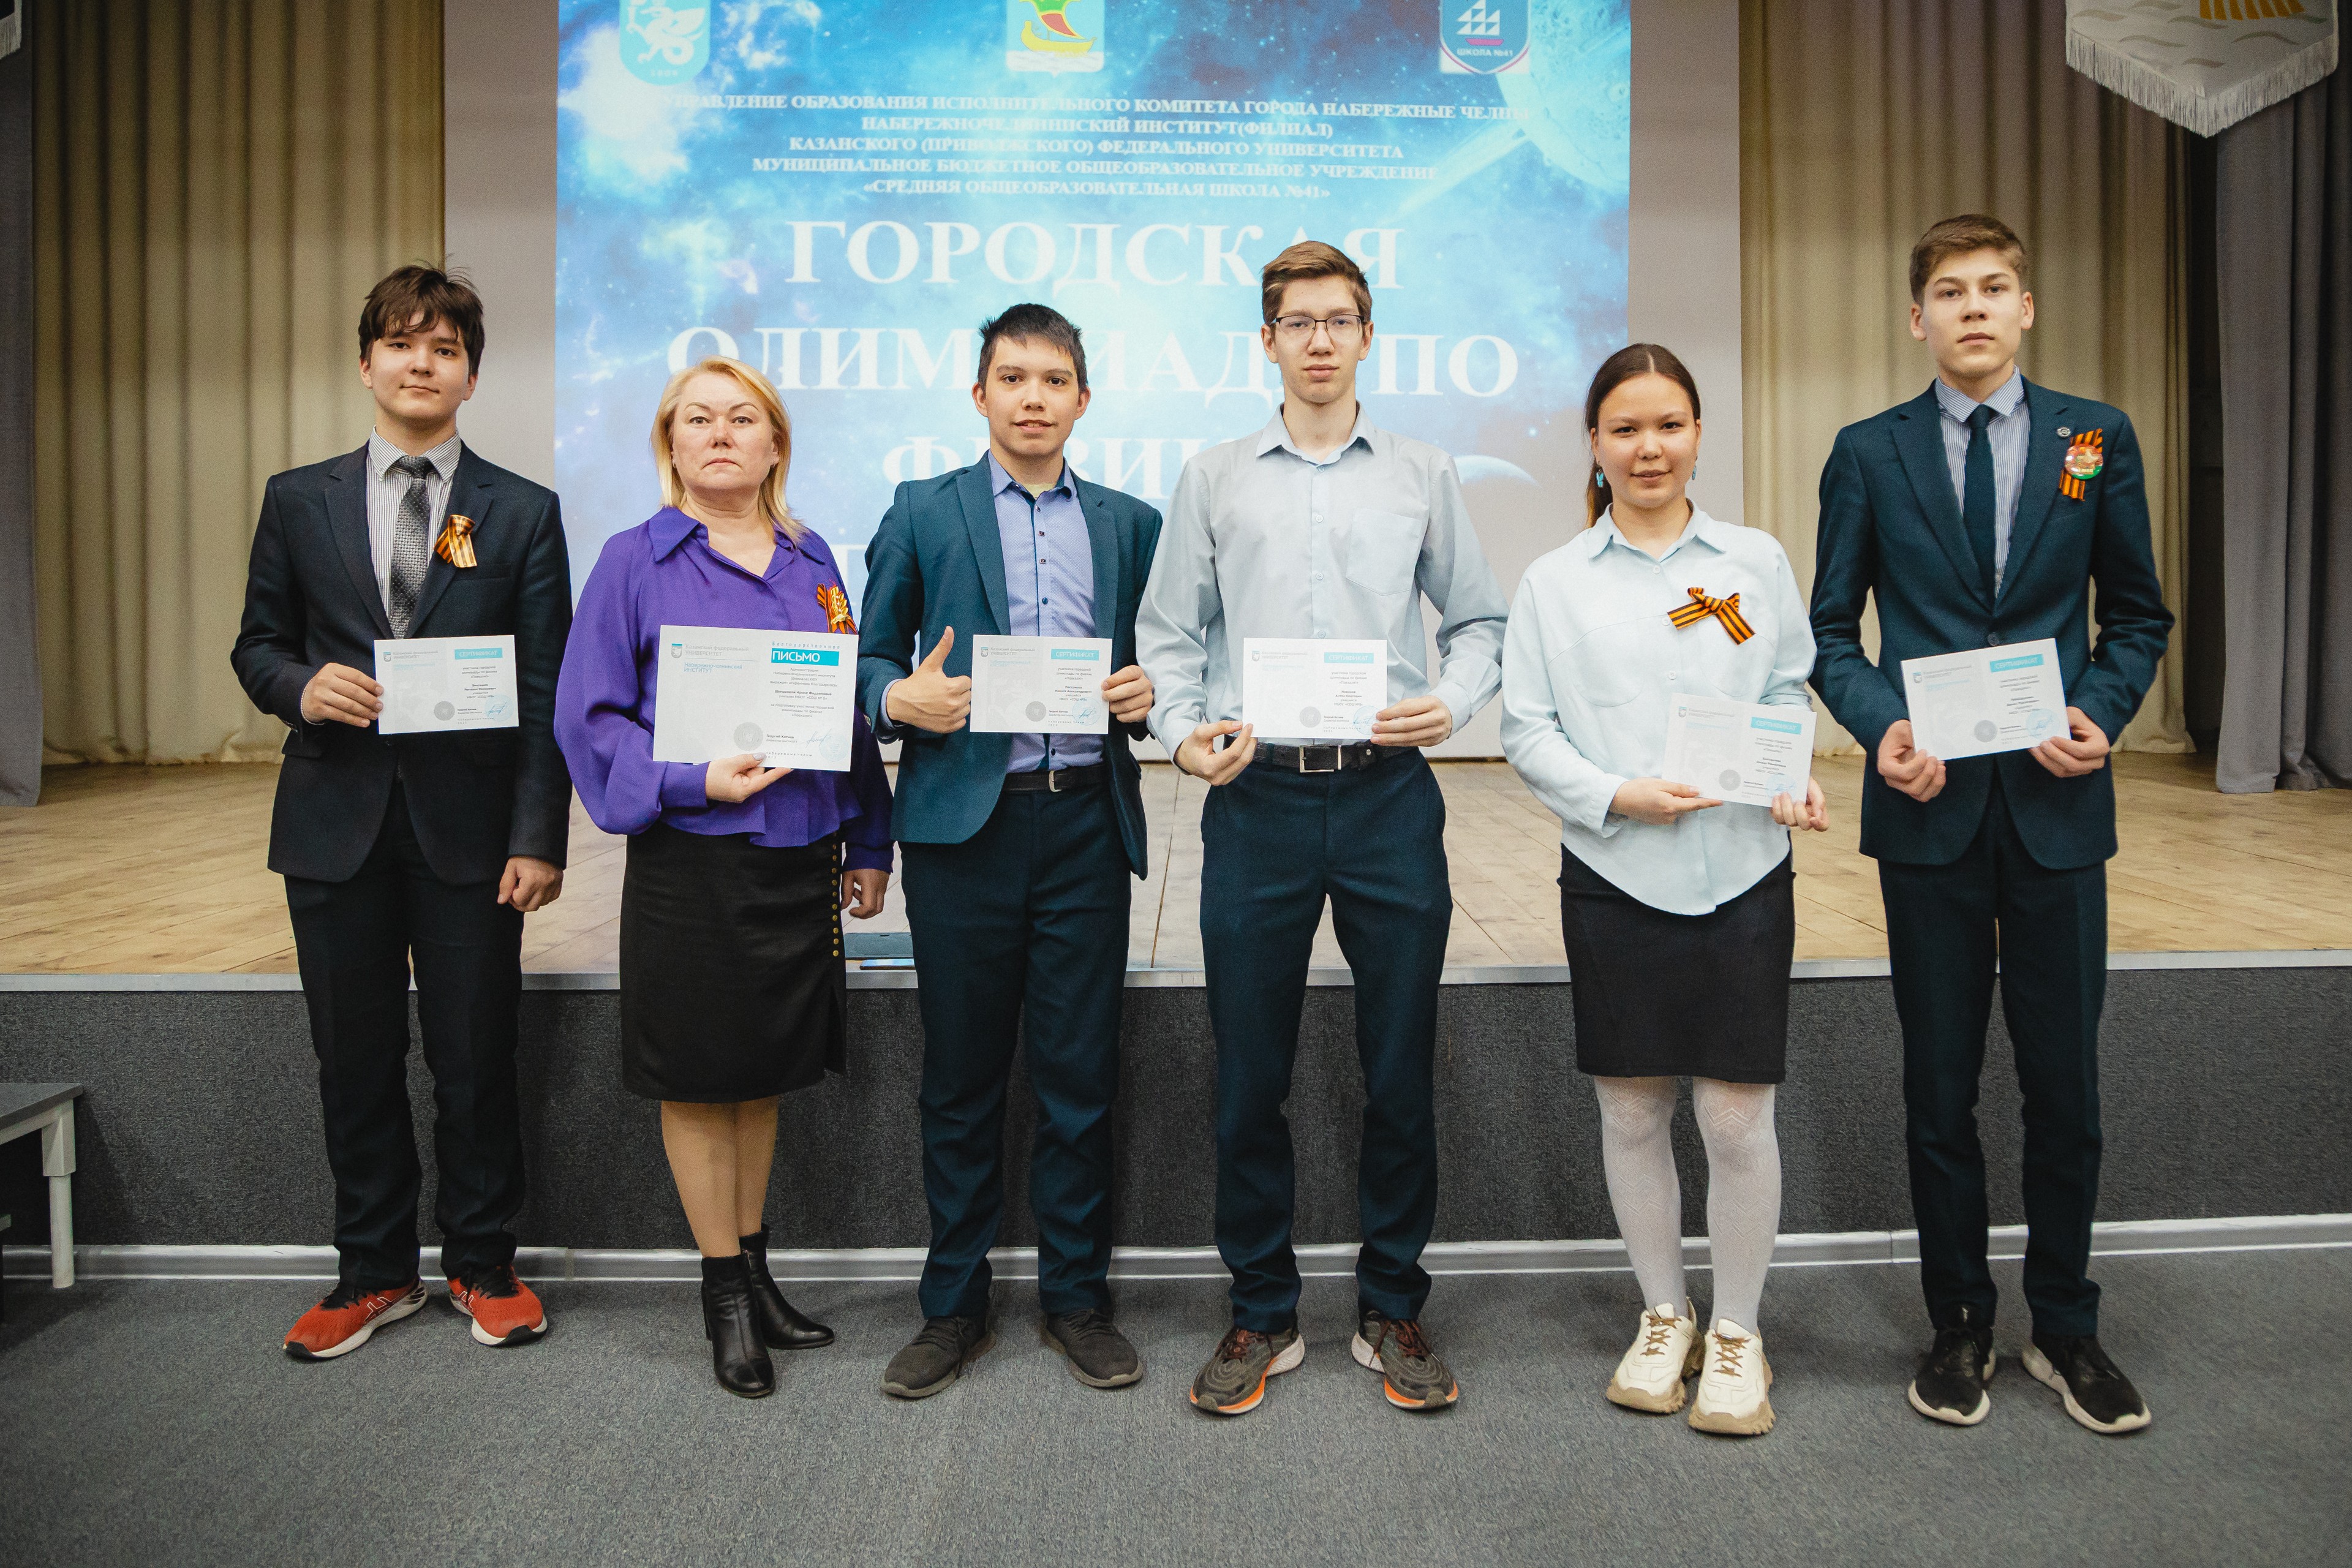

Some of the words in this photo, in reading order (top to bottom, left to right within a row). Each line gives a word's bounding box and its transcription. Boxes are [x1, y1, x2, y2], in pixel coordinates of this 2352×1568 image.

[791, 95, 927, 110] ОБРАЗОВАНИЯ
[932, 96, 1130, 112] ИСПОЛНИТЕЛЬНОГО
[1134, 99, 1240, 114] КОМИТЕТА
[1245, 100, 1318, 116] ГОРОДА
[1322, 102, 1456, 119] НАБЕРЕЖНЫЕ
[1460, 105, 1529, 121] ЧЕЛНЫ
[789, 137, 917, 152] КАЗАНСКОГО
[1097, 140, 1249, 157] ФЕДЕРАЛЬНОГО
[1255, 143, 1404, 159] УНИВЕРСИТЕТА
[752, 157, 932, 173] МУНИЦИПАЛЬНОЕ
[937, 160, 1062, 175] БЮДЖЕТНОЕ
[1066, 161, 1305, 177] ОБЩЕОБРАЗОВАТЕЛЬНОЕ
[1310, 165, 1438, 181] УЧРЕЖДЕНИЕ
[864, 179, 960, 195] «СРЕДНЯЯ
[965, 181, 1204, 197] ОБЩЕОБРАЗОВАТЕЛЬНАЯ
[1210, 183, 1280, 198] ШКОЛА
[1285, 184, 1330, 198] №41»
[785, 220, 1404, 295] ГОРОДСКЯ
[667, 326, 1284, 409] ОЛИМИАД
[1370, 334, 1518, 398] ПО
[772, 650, 820, 663] ПИСЬМО
